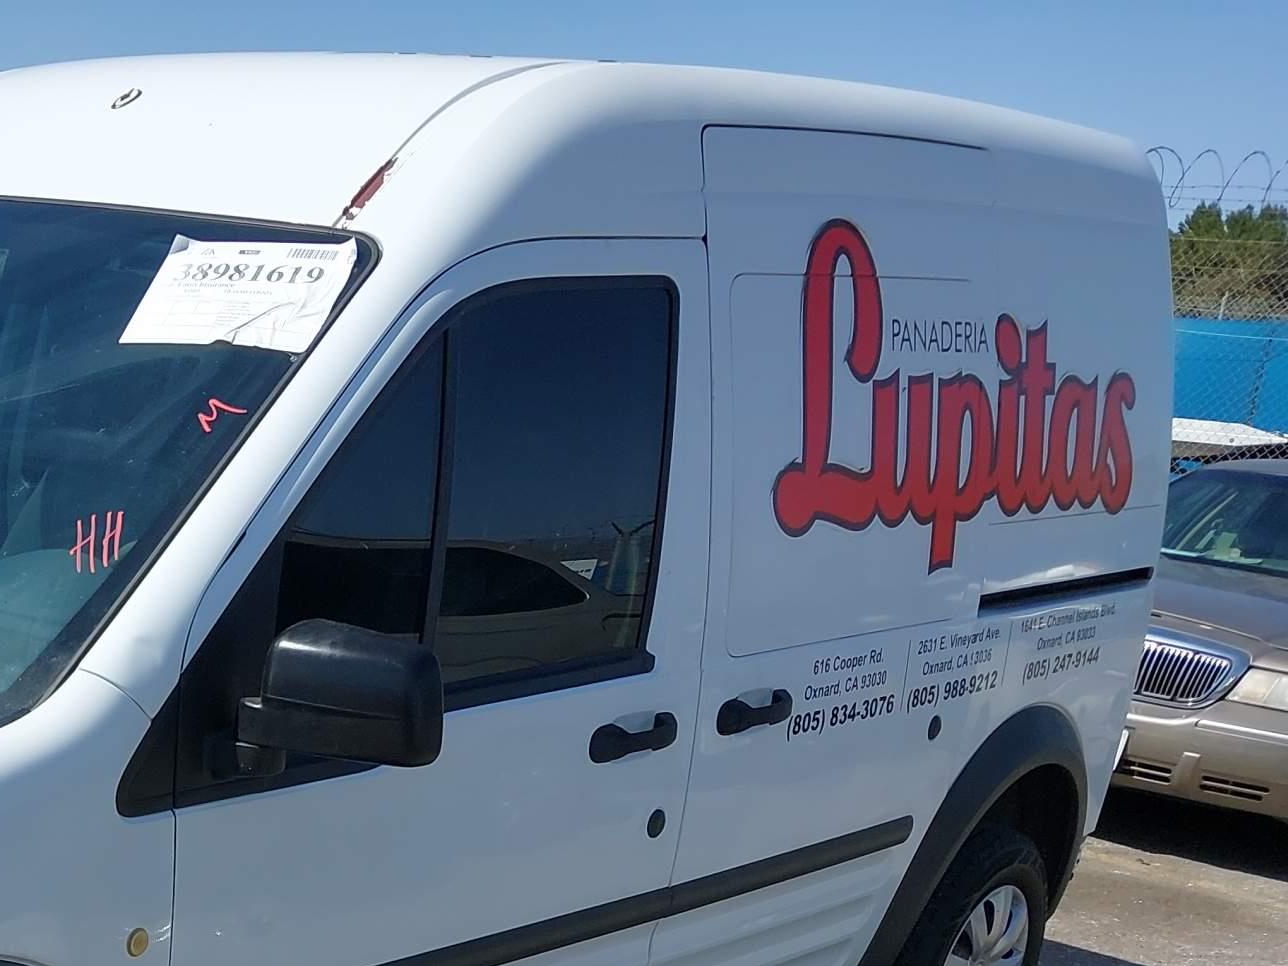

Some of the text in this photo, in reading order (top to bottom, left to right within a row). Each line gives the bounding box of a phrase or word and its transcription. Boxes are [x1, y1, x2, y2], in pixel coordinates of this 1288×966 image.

[174, 263, 325, 284] 38981619
[891, 319, 990, 353] PANADERIA
[772, 217, 1137, 576] Lupitas
[917, 637, 938, 655] 2631
[950, 627, 985, 649] Vineyard
[1065, 629, 1076, 644] CA
[813, 647, 884, 675] 616 Cooper Rd.
[922, 656, 954, 676] Oxnard,
[956, 653, 968, 669] CA
[1022, 646, 1101, 686] (805) 247-9144
[804, 670, 888, 701] Oxnard, CA 93030
[906, 670, 998, 714] (805) 988-9212
[786, 693, 895, 742] (805) 834-3076
